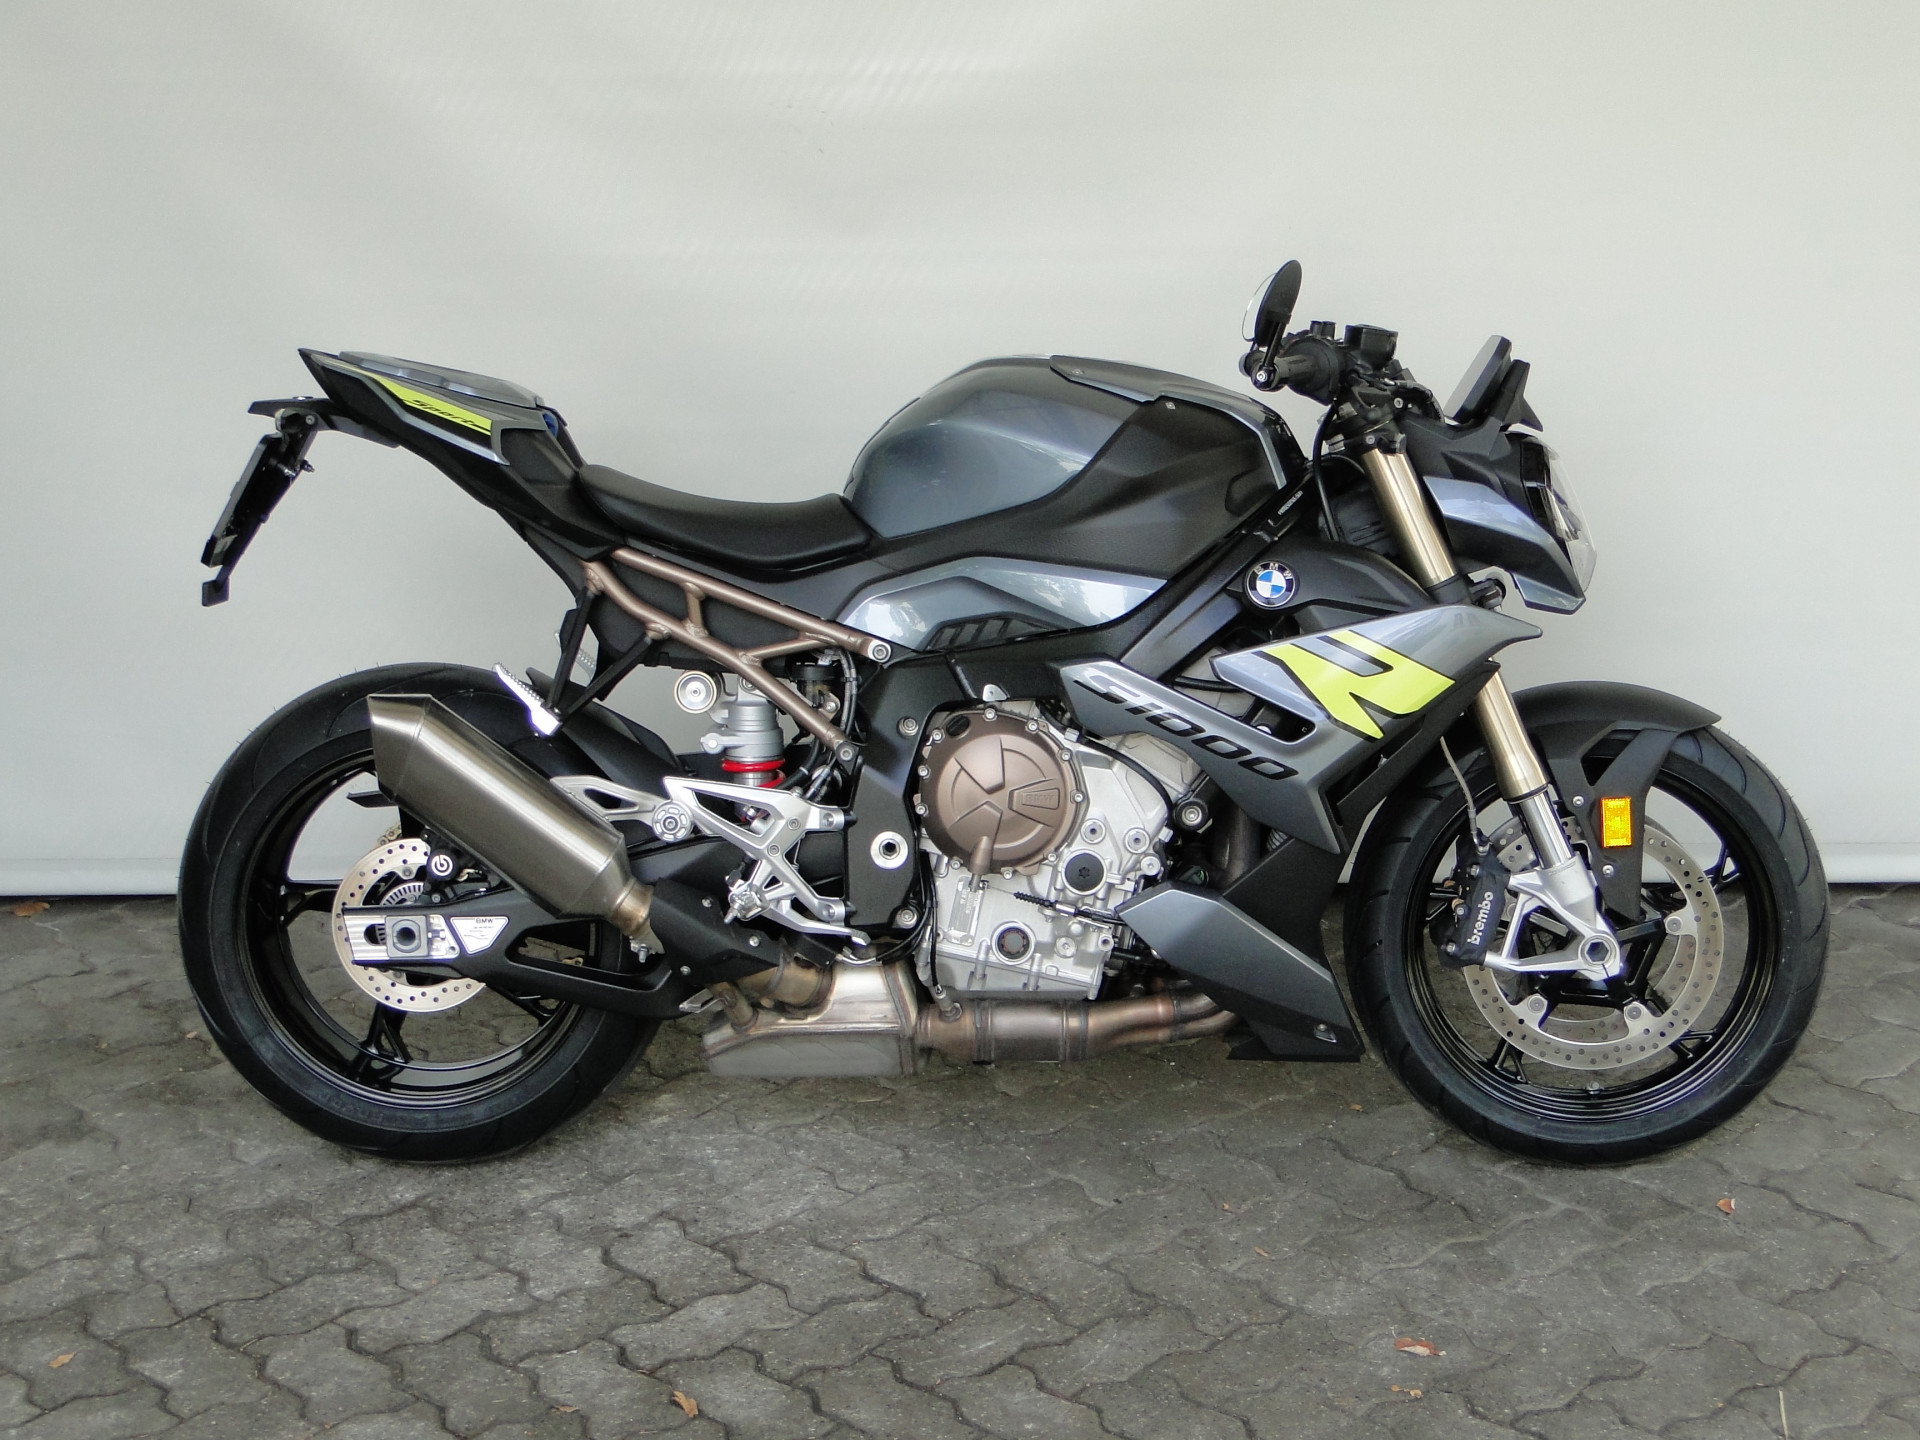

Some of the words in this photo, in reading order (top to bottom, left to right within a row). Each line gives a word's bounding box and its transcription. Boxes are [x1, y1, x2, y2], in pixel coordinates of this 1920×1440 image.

[407, 399, 476, 426] Sport
[1253, 562, 1293, 580] BMW
[475, 917, 495, 925] BMW
[1467, 891, 1494, 945] brembo
